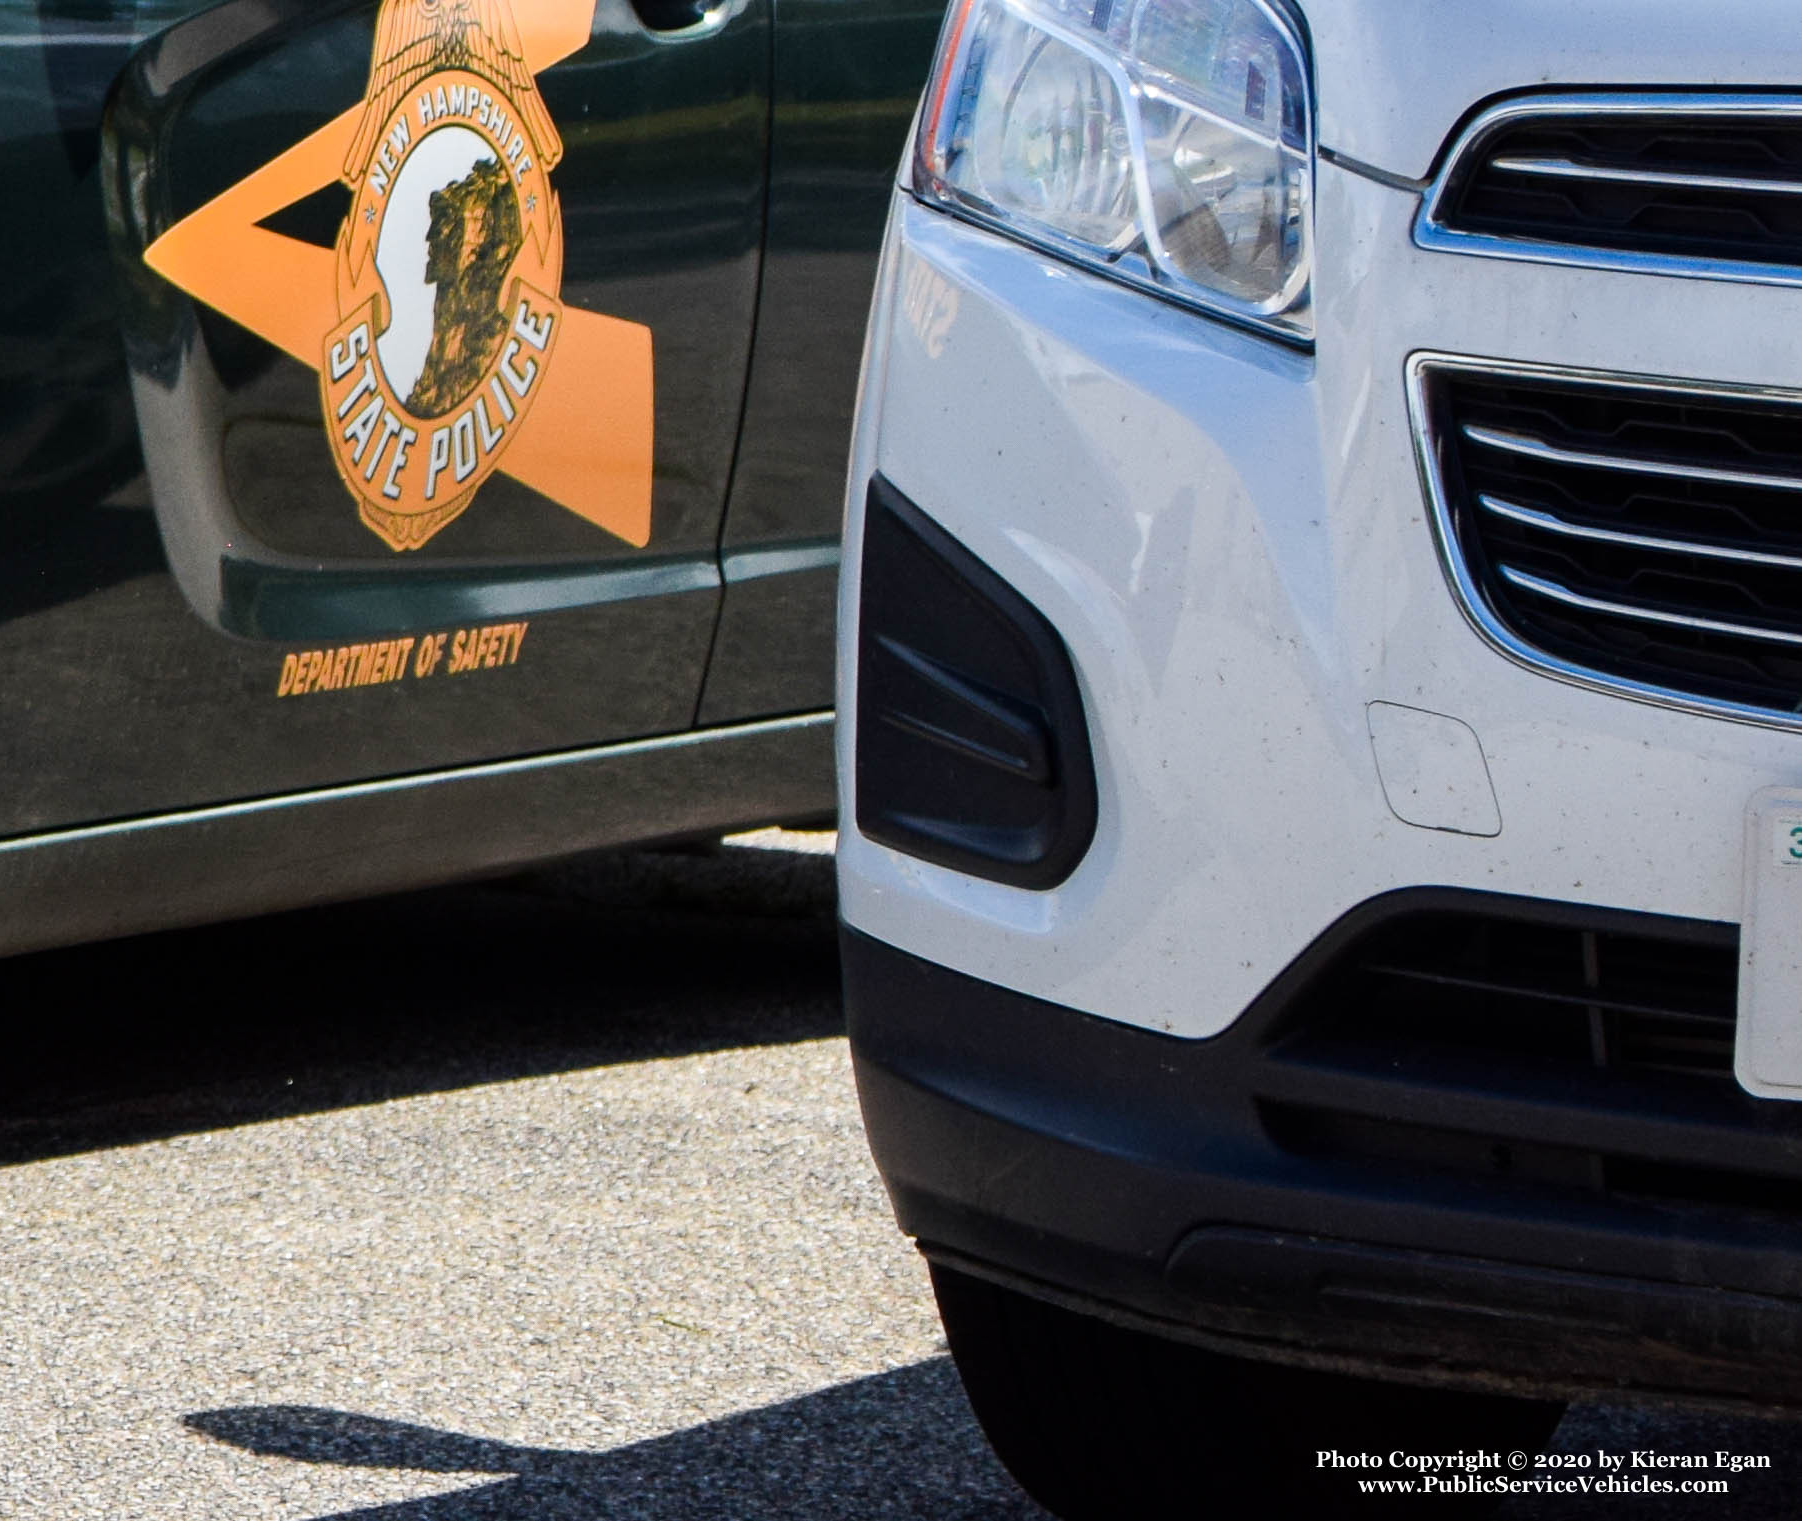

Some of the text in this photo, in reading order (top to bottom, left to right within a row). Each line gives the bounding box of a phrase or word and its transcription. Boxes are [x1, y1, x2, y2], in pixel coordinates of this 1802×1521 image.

[369, 84, 533, 197] NEW HAMPSHIRE
[330, 299, 555, 500] STATE POLICE
[276, 622, 530, 698] DEPARTMENT OF SAFETY
